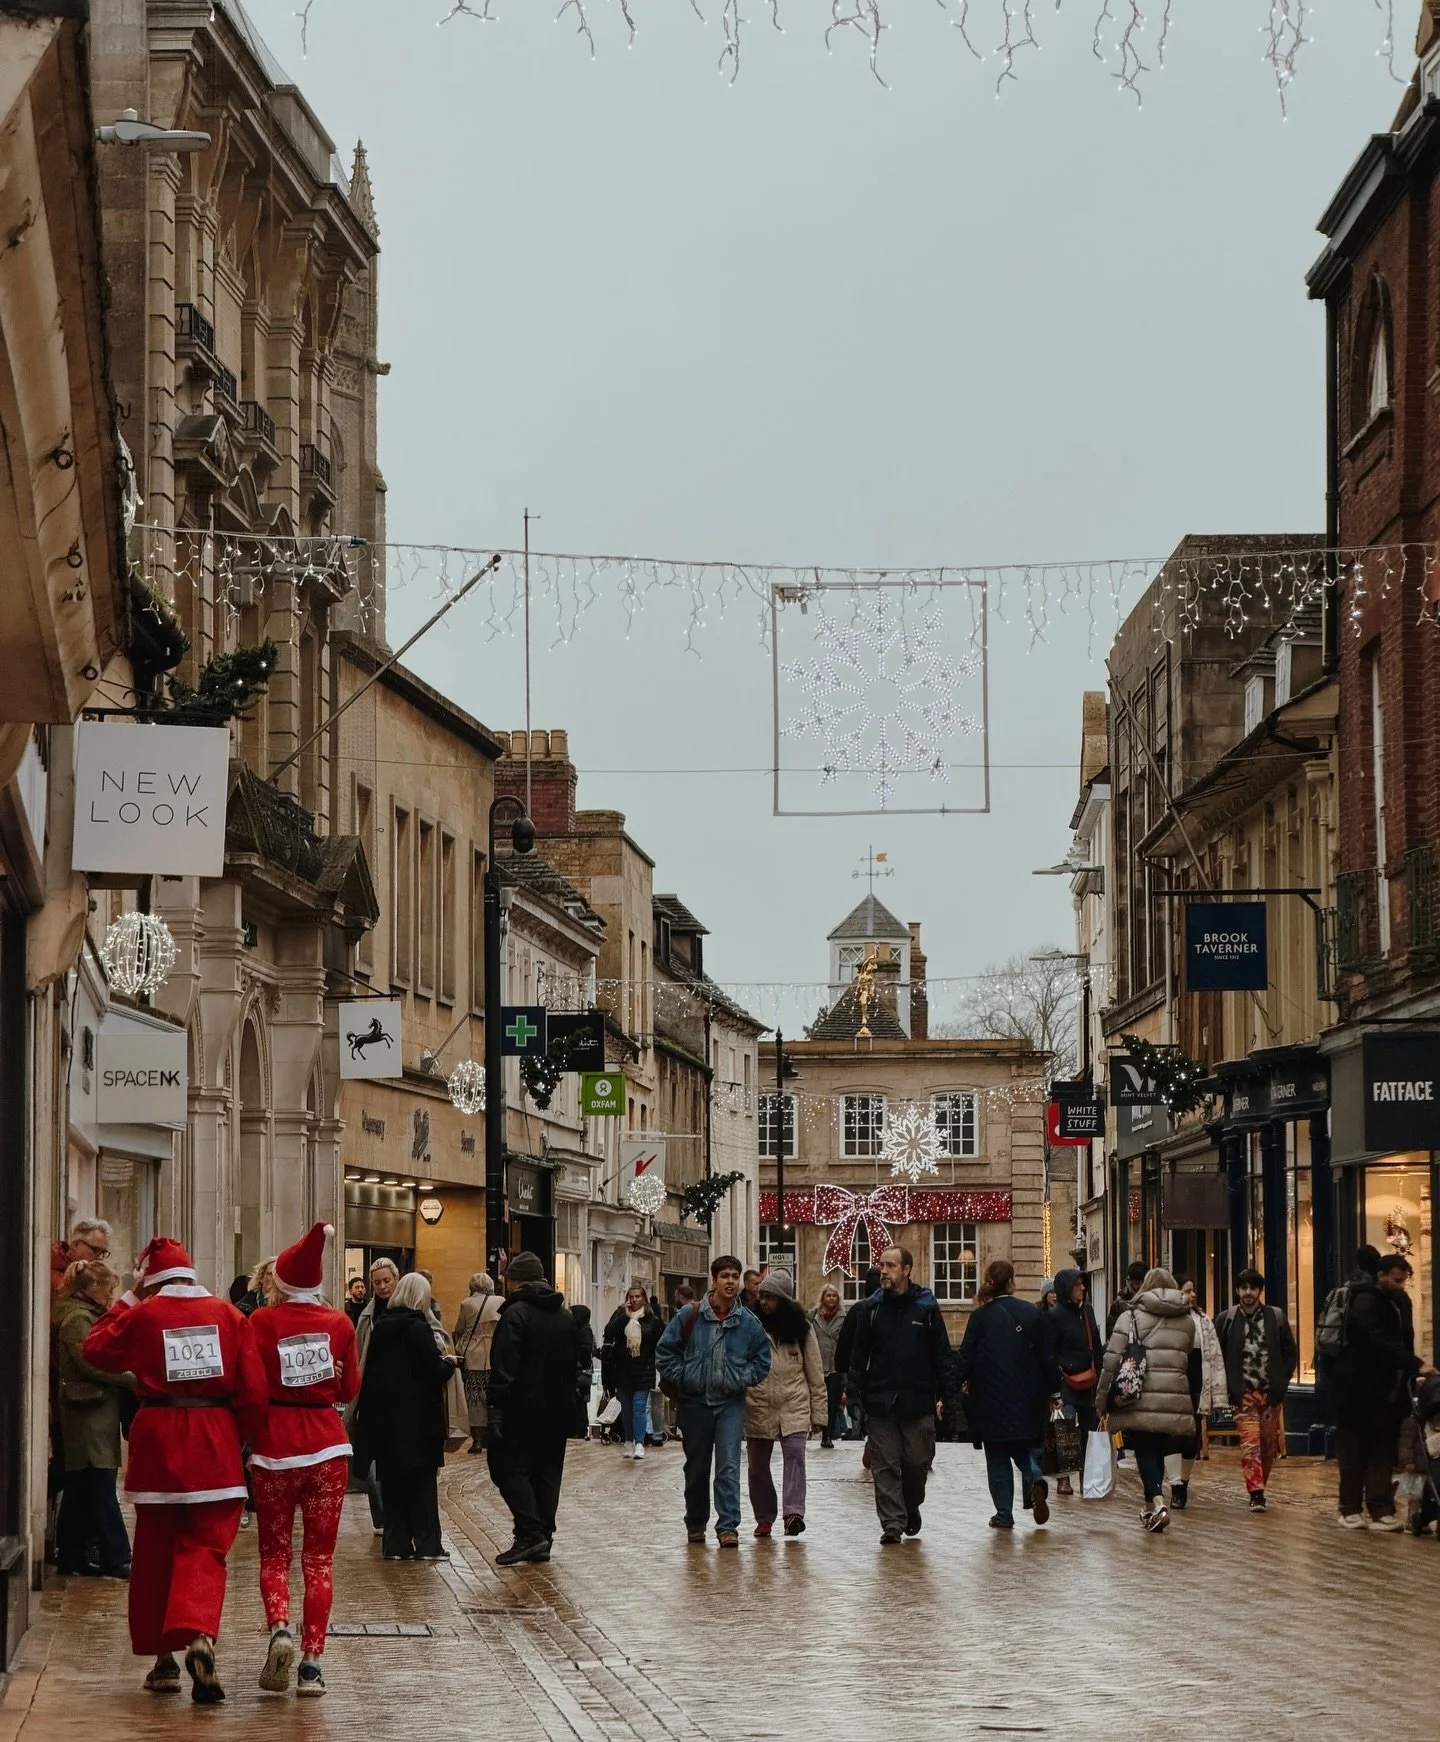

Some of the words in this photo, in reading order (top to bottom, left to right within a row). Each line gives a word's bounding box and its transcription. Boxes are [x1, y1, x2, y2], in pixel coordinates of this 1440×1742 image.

[102, 770, 201, 795] NEW
[91, 801, 209, 827] LOOK
[1204, 933, 1248, 943] BROOK
[1195, 943, 1258, 954] TAVERNER
[1373, 1081, 1434, 1101] FATFACE
[591, 1100, 616, 1109] OXFAM
[1067, 1106, 1097, 1115] WHITE
[1067, 1119, 1097, 1128] STUFF
[169, 1343, 218, 1361] 1021
[284, 1346, 329, 1368] 1020
[177, 1368, 212, 1378] ZEECO
